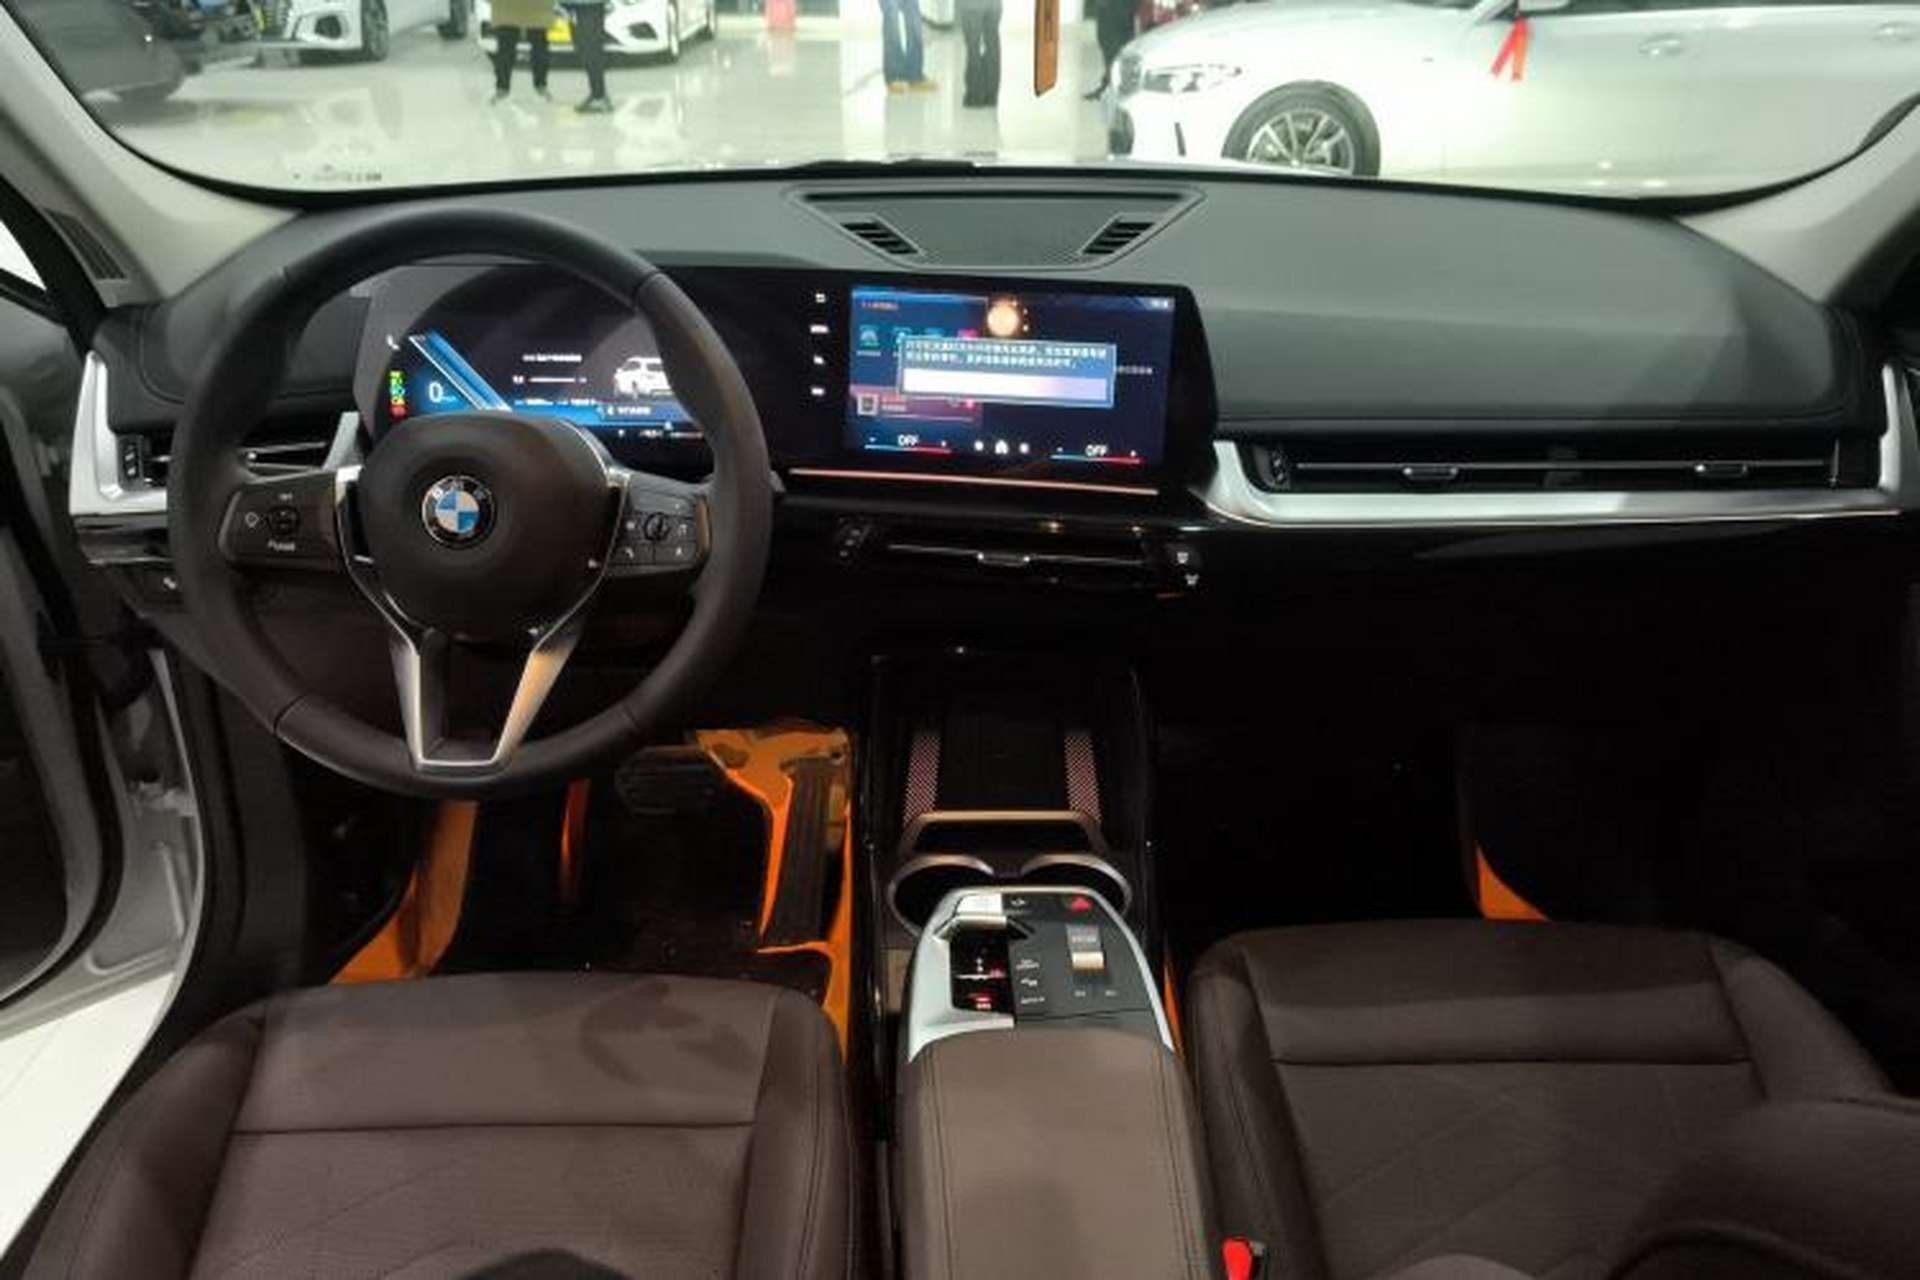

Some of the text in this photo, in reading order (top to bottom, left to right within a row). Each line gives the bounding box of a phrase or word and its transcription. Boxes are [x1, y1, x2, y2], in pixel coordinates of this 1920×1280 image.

[428, 381, 445, 403] 0
[897, 434, 919, 448] OFF
[1085, 444, 1108, 458] OFF
